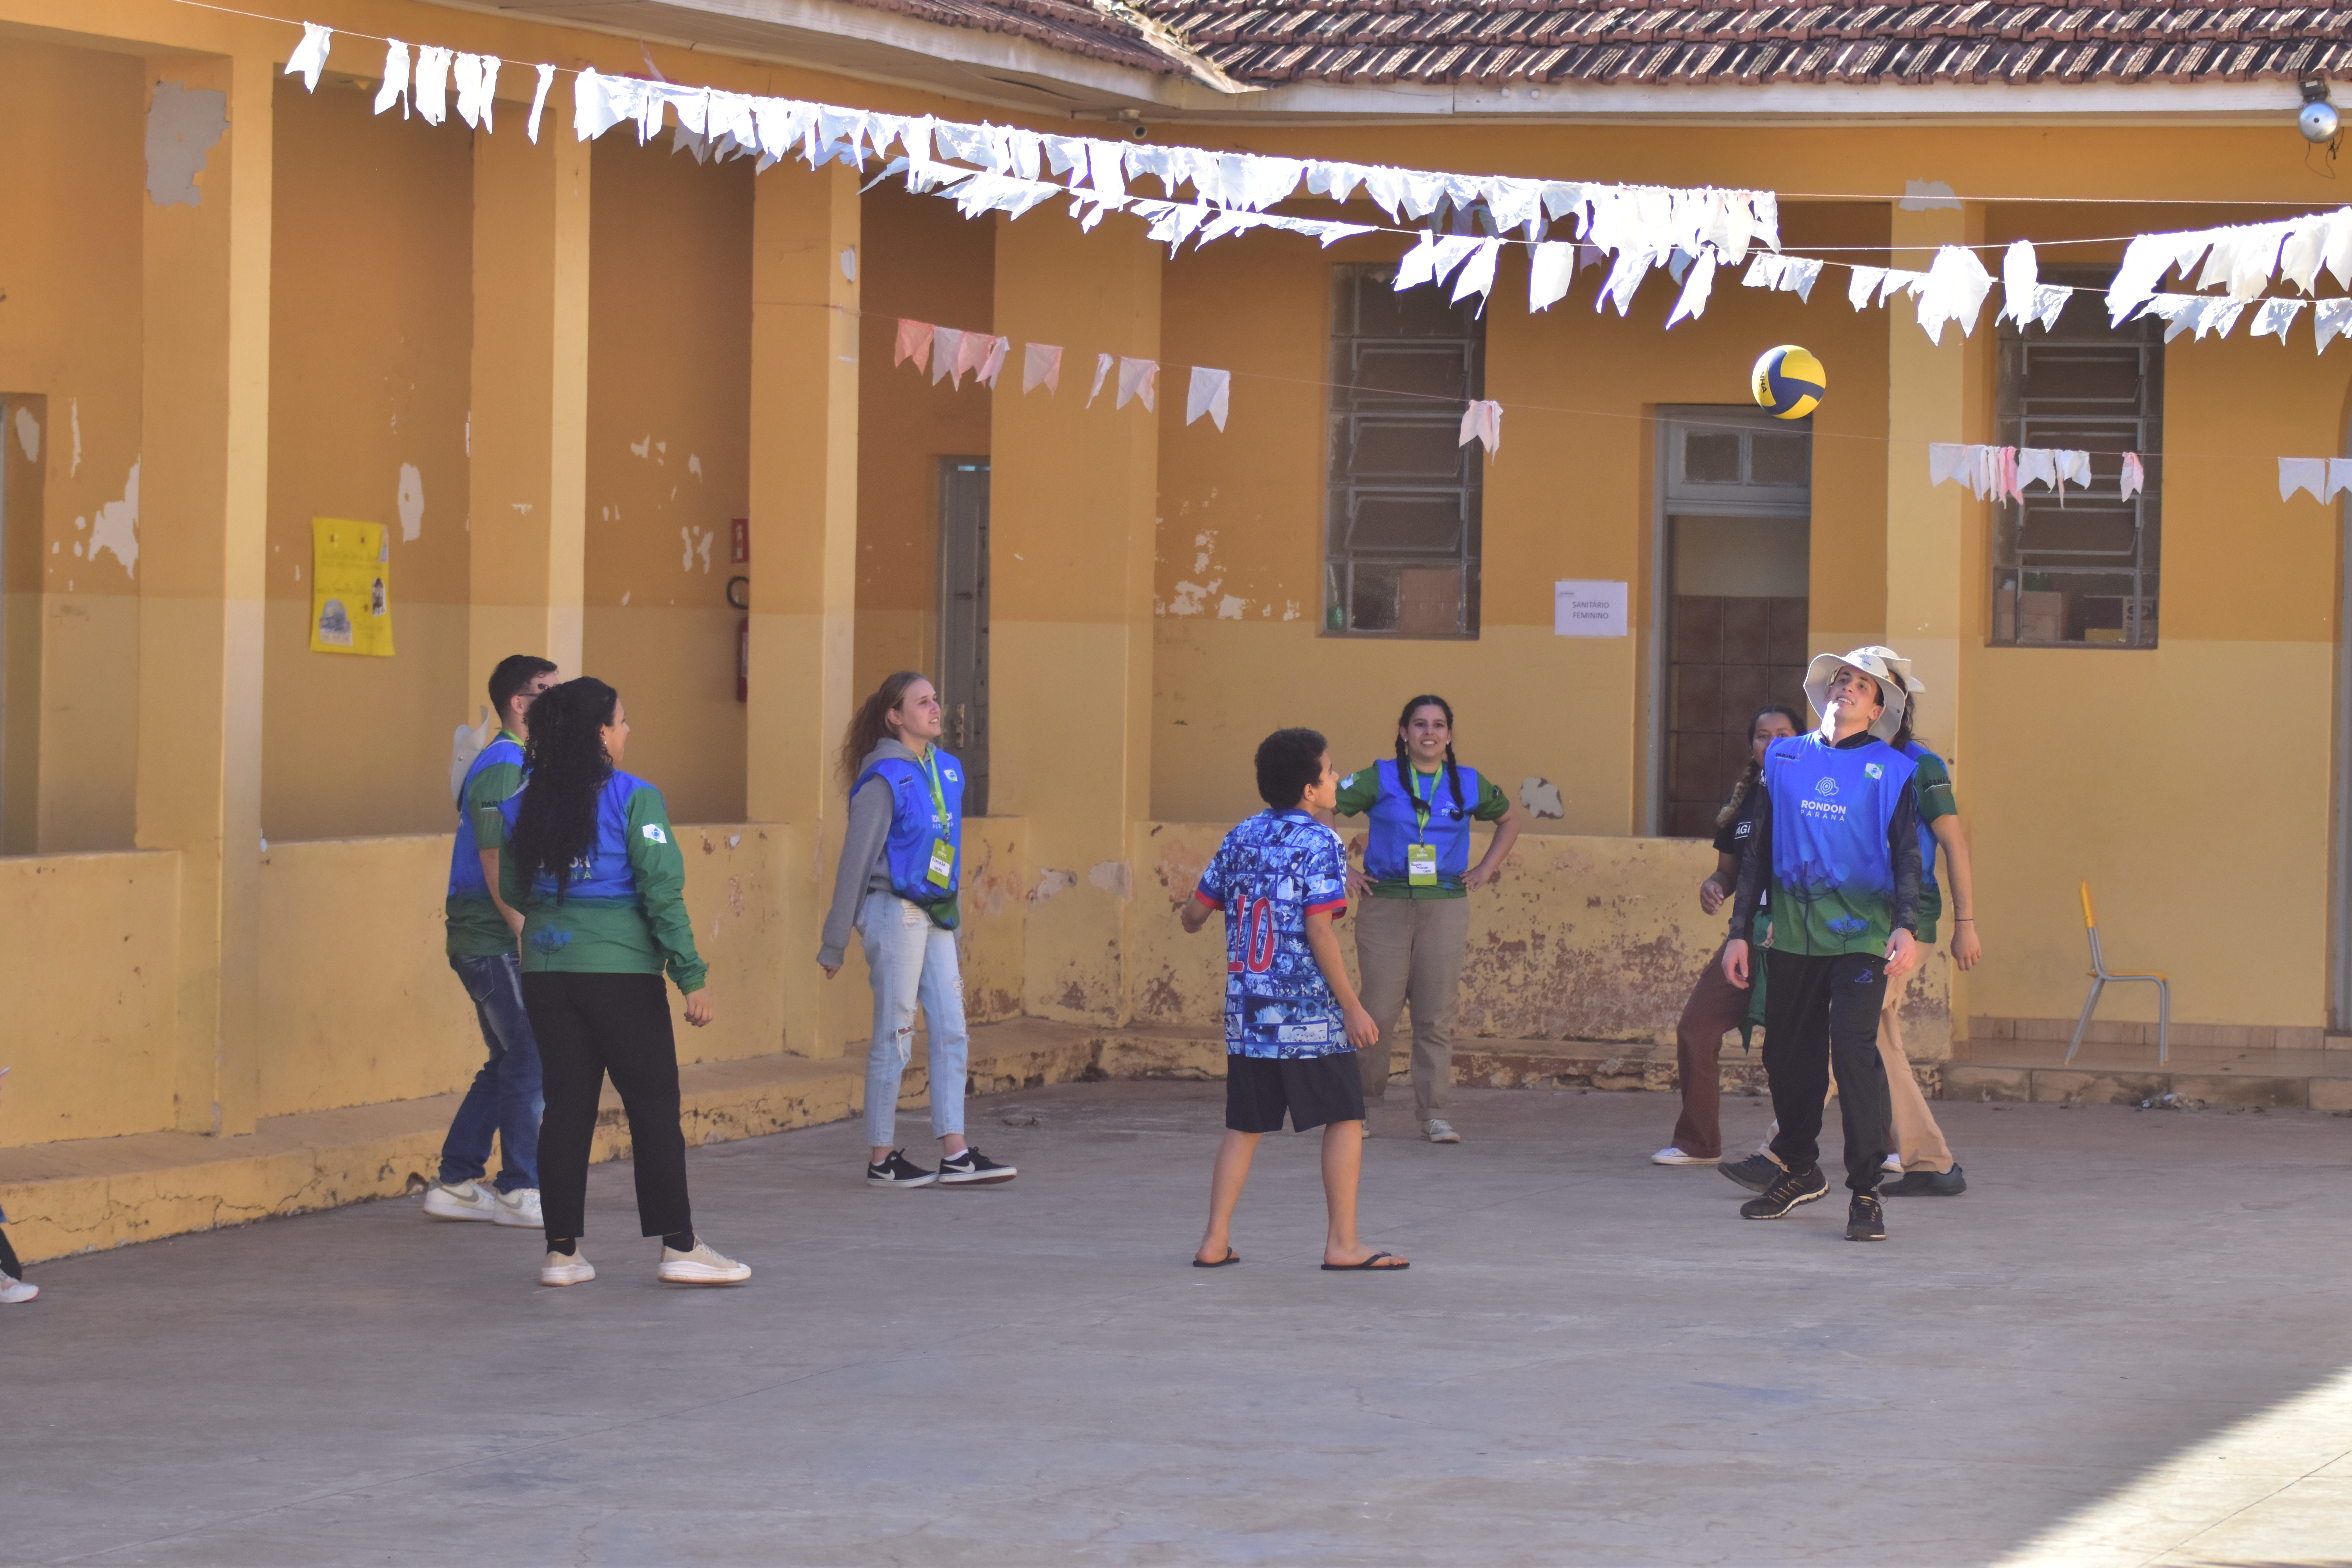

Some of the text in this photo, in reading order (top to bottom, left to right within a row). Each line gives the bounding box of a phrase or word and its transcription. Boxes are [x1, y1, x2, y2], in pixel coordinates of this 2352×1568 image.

[1801, 800, 1846, 815] RONDON
[932, 857, 946, 867] NAIARA
[1228, 894, 1275, 974] 10
